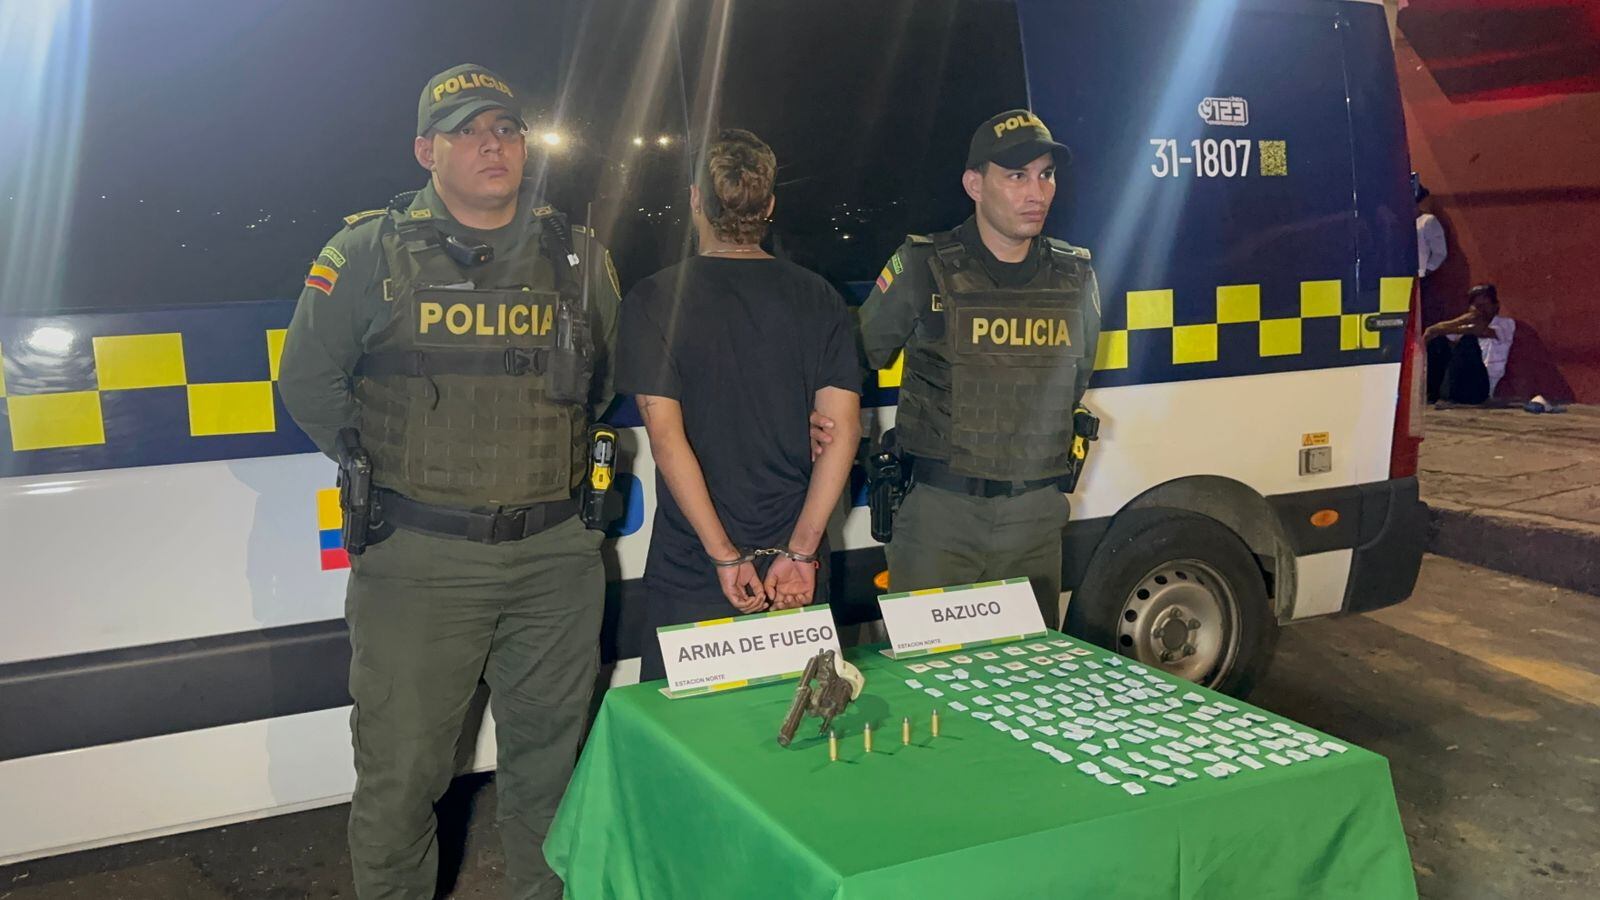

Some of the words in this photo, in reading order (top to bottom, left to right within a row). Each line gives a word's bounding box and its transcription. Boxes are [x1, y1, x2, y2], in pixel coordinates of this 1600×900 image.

[1213, 101, 1245, 121] 123
[1150, 138, 1251, 178] 31-1807
[420, 302, 553, 336] POLICIA
[972, 317, 1071, 346] POLICIA
[931, 601, 1001, 623] BAZUCO
[678, 640, 735, 663] ARMA
[739, 635, 766, 653] DE
[769, 625, 833, 648] FUEGO
